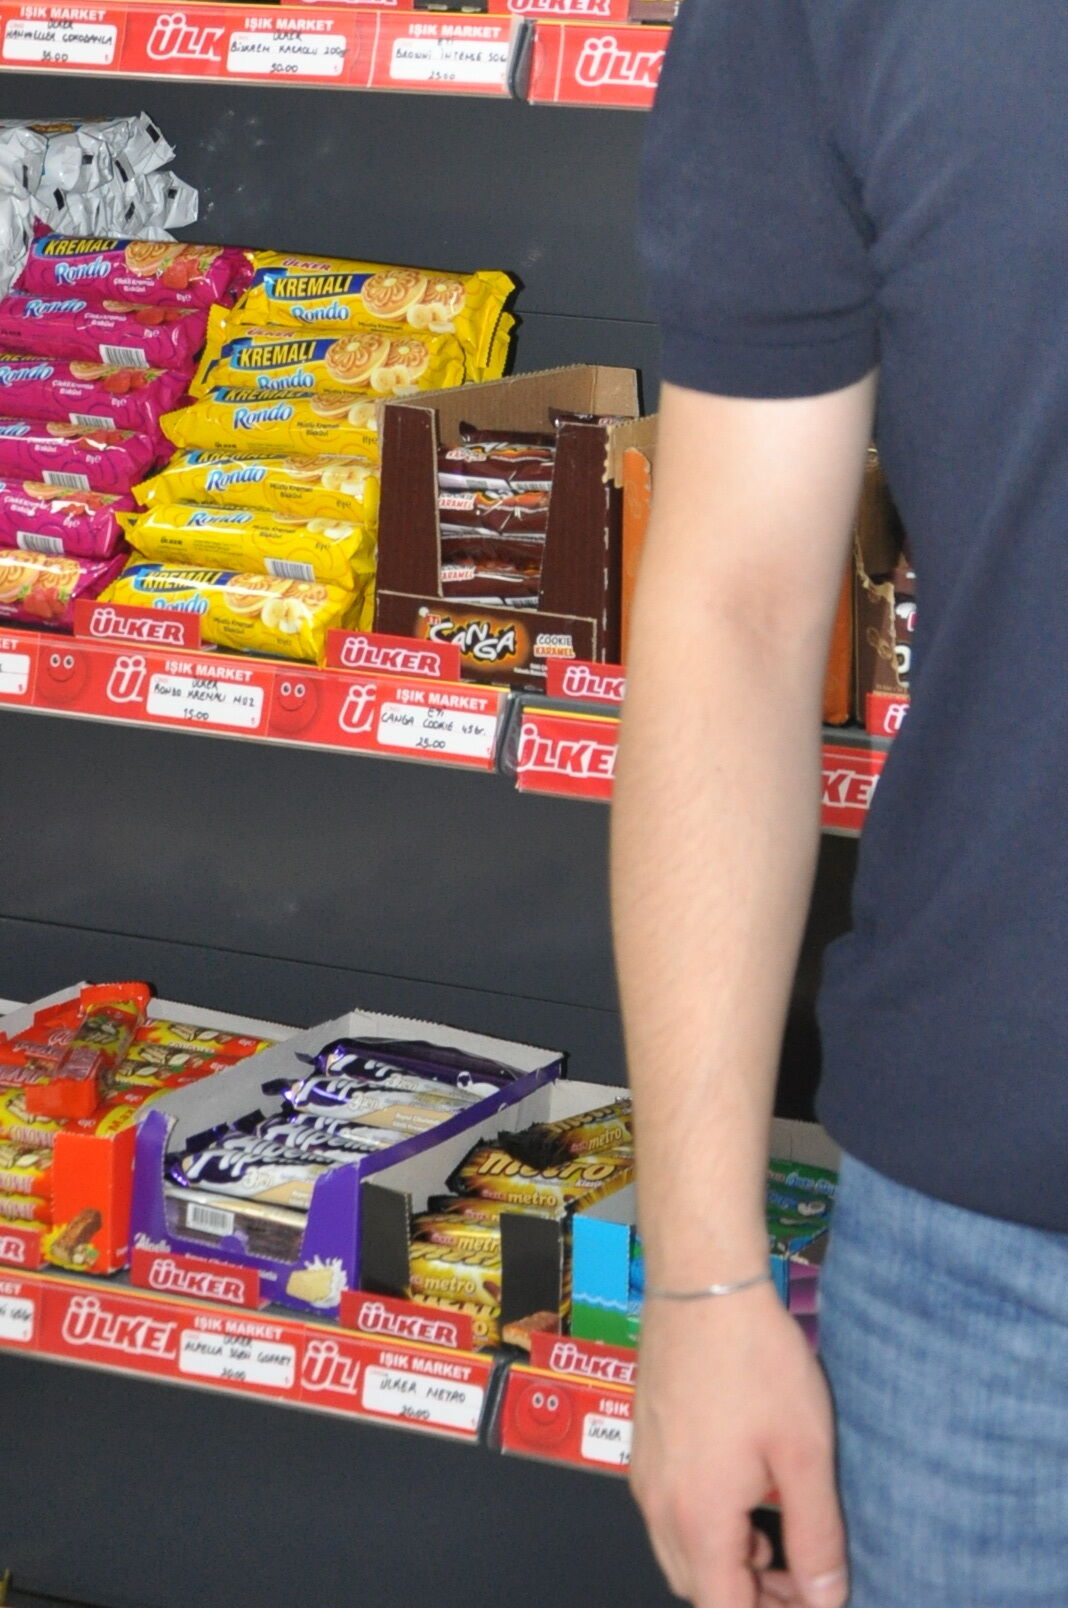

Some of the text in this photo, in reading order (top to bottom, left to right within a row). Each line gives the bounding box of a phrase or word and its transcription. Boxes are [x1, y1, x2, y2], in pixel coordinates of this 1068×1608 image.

[20, 5, 107, 22] IŞIK MARKET
[244, 17, 335, 32] IŞIK MARKET
[146, 12, 225, 62] ÜLK
[408, 23, 502, 39] IŞIK MARKET
[574, 35, 666, 88] ÜLK
[44, 238, 119, 256] KREMALI
[54, 255, 113, 287] Rondo
[282, 258, 332, 272] ÜLKER
[274, 274, 353, 299] KREMALI
[21, 298, 88, 320] Rondo
[290, 298, 351, 324] Rondo
[239, 340, 317, 369] KREMALI
[256, 367, 315, 391] Rondo
[232, 400, 294, 431] Rondo
[205, 462, 268, 493] Rondo
[185, 510, 254, 528] Rondo
[89, 607, 185, 646] ÜLKER
[428, 620, 516, 662] CANGA
[533, 645, 576, 659] KARAMEL
[536, 633, 573, 647] COOKIE
[340, 636, 441, 677] ÜLKER
[165, 660, 254, 682] IŞIK MARKET
[562, 665, 627, 701] ÜLK
[395, 688, 489, 711] IŞIK MARKET
[588, 1126, 623, 1151] metro
[507, 1191, 558, 1208] metro
[457, 1234, 500, 1253] metr
[149, 1257, 245, 1304] ÜLKER
[424, 1275, 476, 1294] metro
[61, 1295, 178, 1361] ÜLKE
[193, 1315, 284, 1340] IŞIK MARKET
[357, 1300, 458, 1349] ÜLKER
[379, 1351, 472, 1381] IŞIK MARKET
[599, 1398, 631, 1417] IŞIK
